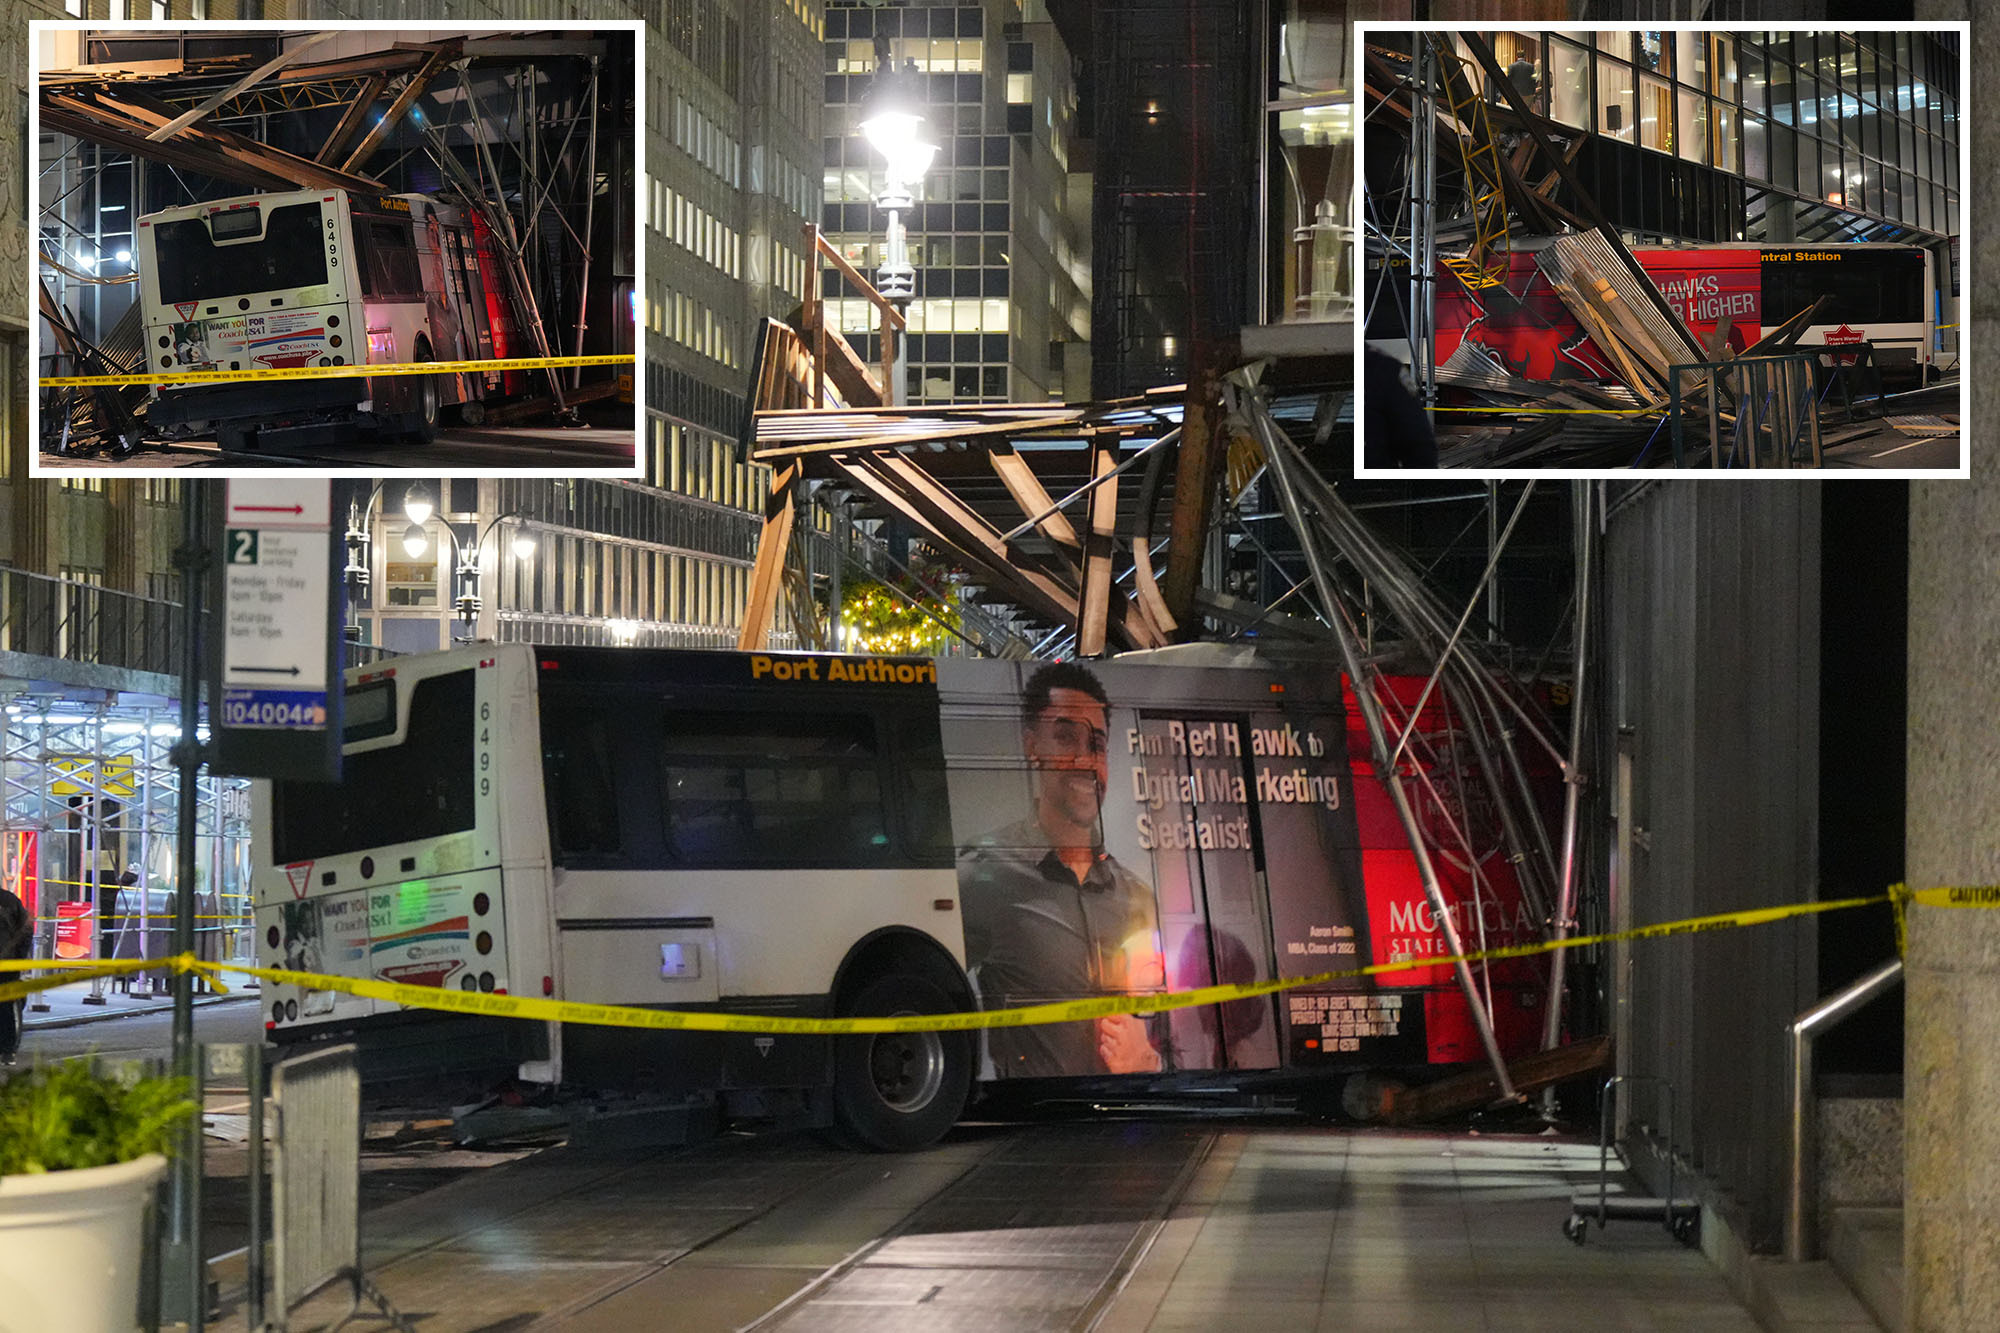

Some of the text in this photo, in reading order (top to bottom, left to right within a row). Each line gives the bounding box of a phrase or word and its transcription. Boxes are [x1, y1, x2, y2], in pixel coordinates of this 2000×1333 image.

[327, 219, 338, 267] 6499
[1795, 252, 1841, 261] Station
[1689, 293, 1755, 322] HIGHER
[207, 322, 230, 331] WANT
[232, 320, 246, 328] YOU
[248, 318, 264, 326] FOR
[234, 531, 252, 563] 2
[751, 656, 820, 680] Port
[480, 702, 490, 796] 6499
[1169, 720, 1218, 757] Red
[1222, 722, 1303, 758] Hawk
[1208, 768, 1340, 810] Marketing
[324, 902, 348, 917] WANT
[371, 894, 391, 910] FOR
[1308, 942, 1328, 954] Class
[1328, 942, 1336, 954] of
[1337, 942, 1356, 954] 2022
[1392, 937, 1444, 954] STATE
